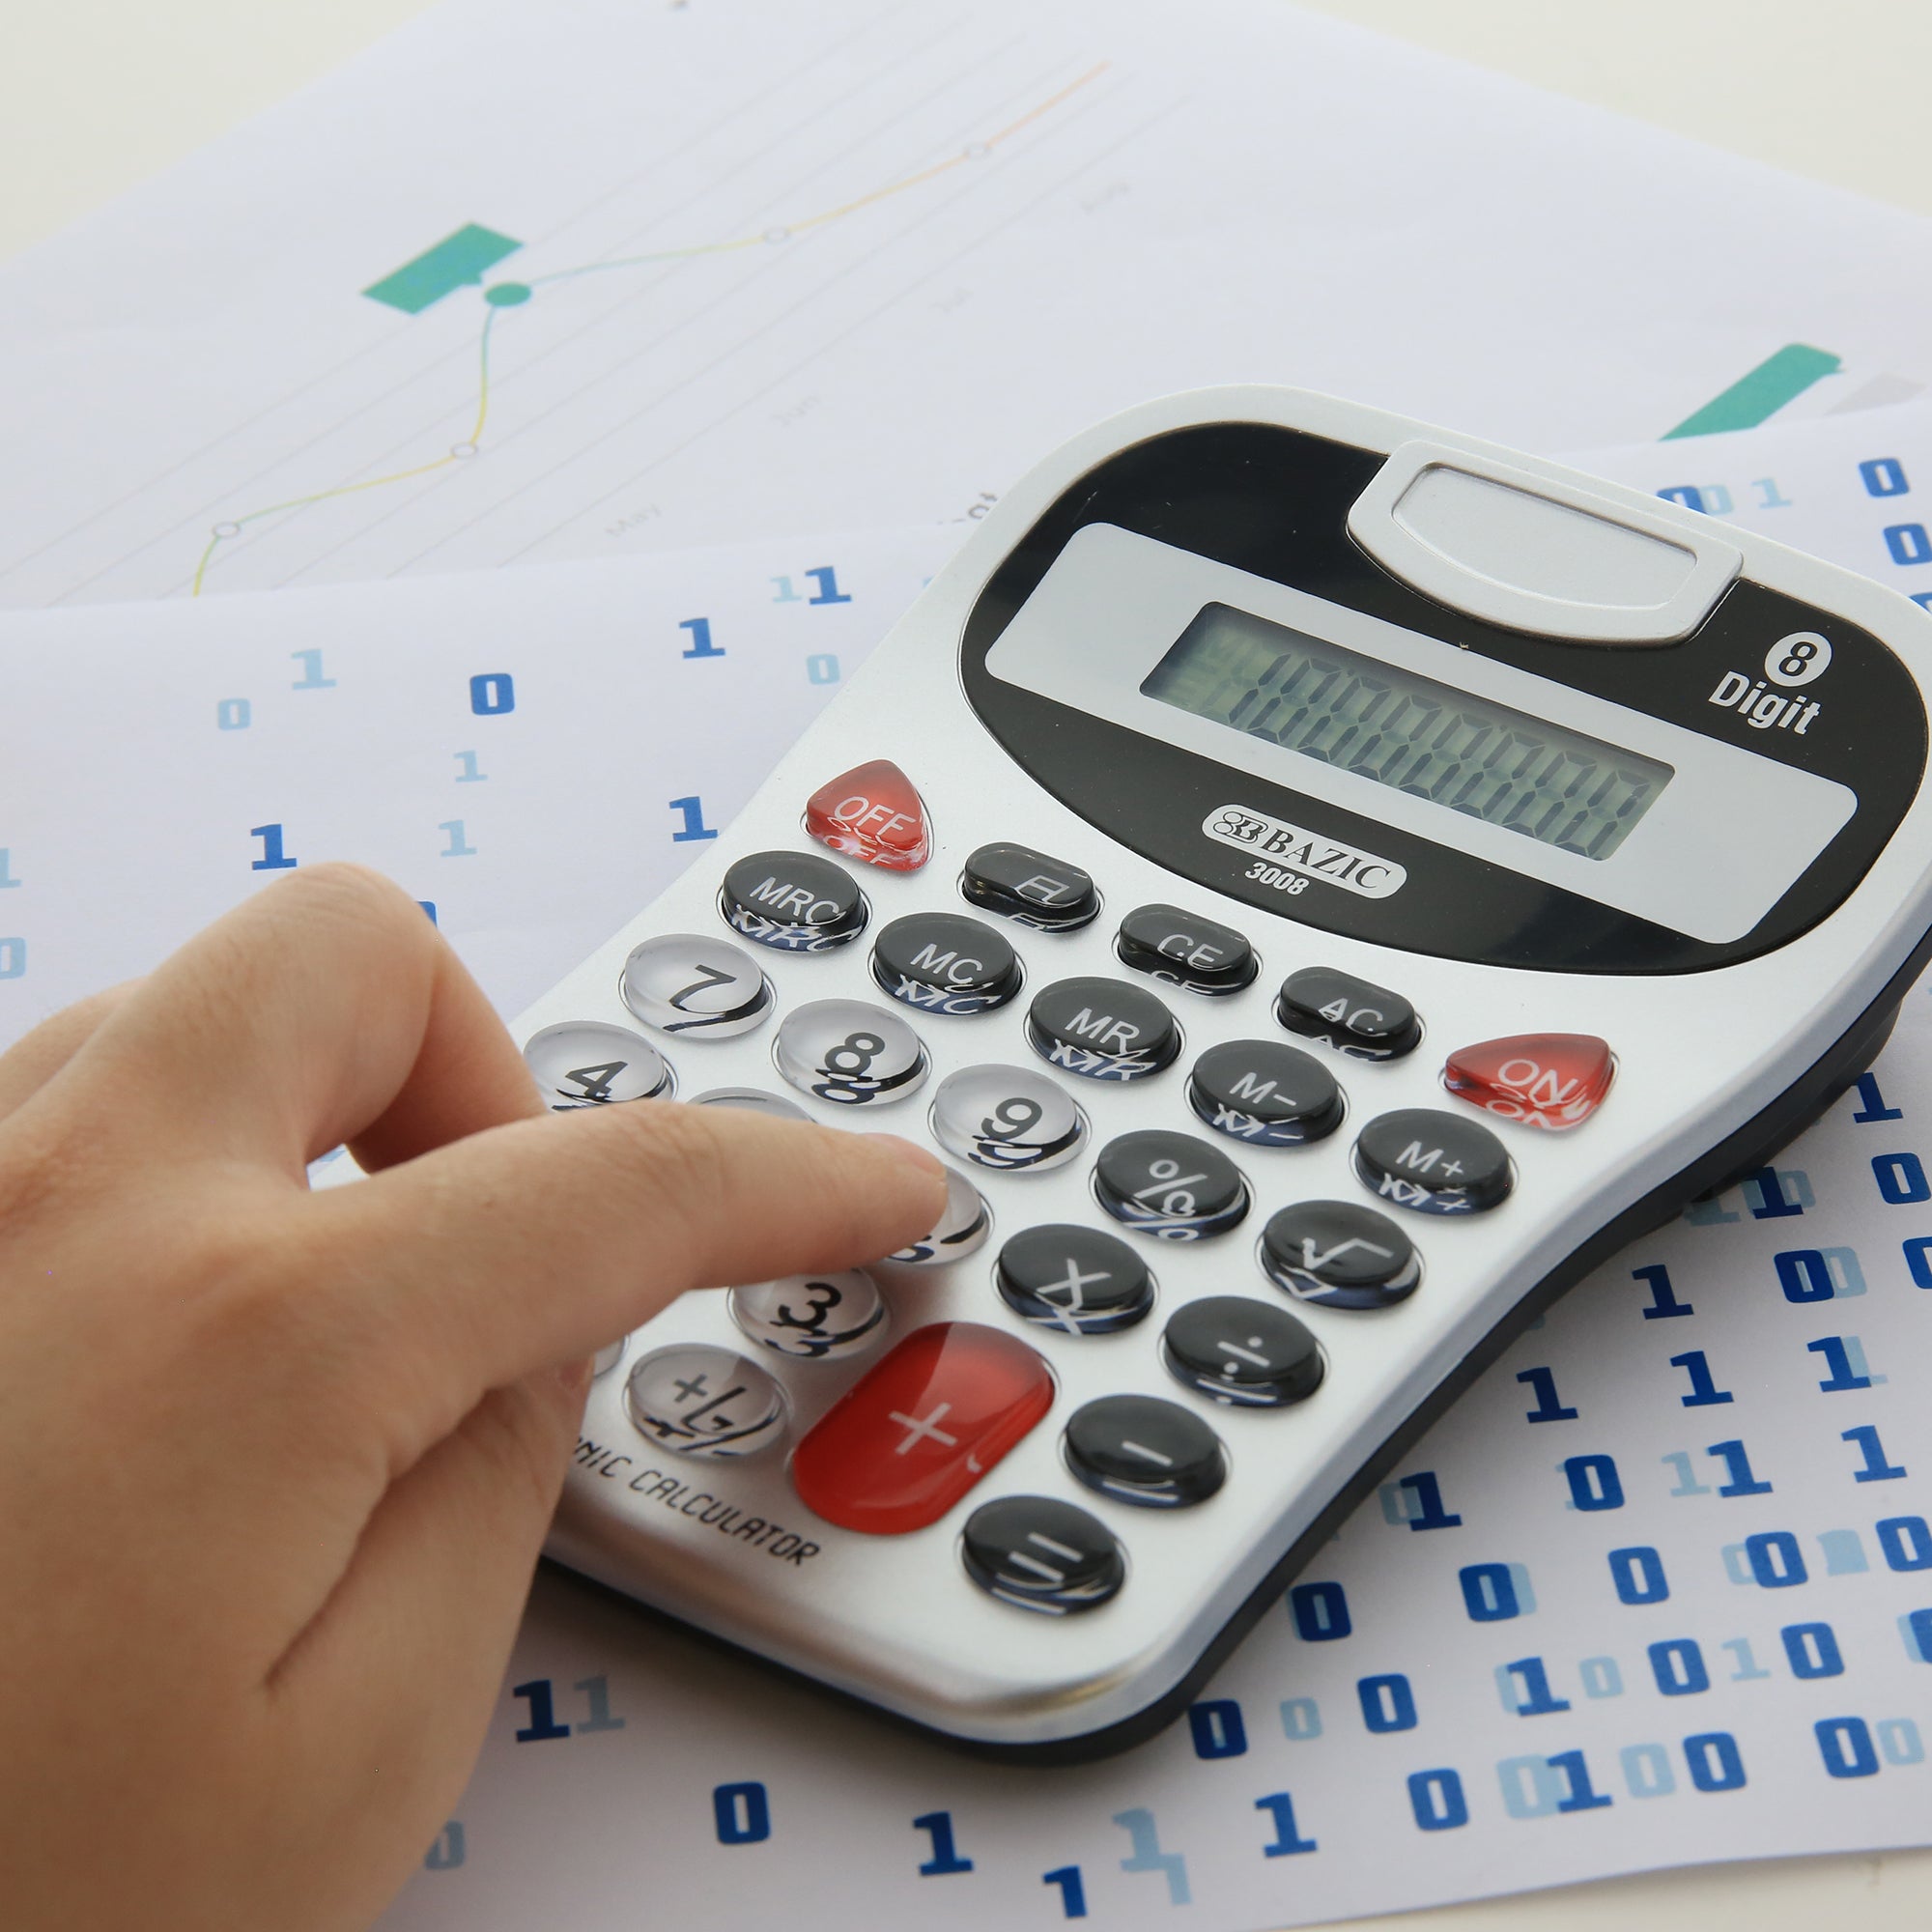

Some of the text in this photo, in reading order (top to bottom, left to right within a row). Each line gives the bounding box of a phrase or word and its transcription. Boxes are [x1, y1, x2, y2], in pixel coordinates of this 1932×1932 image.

[1751, 478, 1793, 510] 1
[1858, 457, 1911, 498] 0
[603, 502, 664, 539] May
[1882, 523, 1932, 567] 0
[771, 576, 803, 604] 1
[804, 566, 854, 607] 1
[678, 617, 727, 661] 1
[1778, 640, 1819, 678] 8
[293, 648, 338, 692] 1
[469, 672, 517, 717] 0
[807, 654, 841, 687] 0
[217, 697, 252, 731] 0
[1708, 669, 1822, 736] Digit
[454, 750, 489, 784] 1
[439, 819, 478, 859] 1
[669, 796, 720, 843] 1
[834, 795, 918, 838] OFF
[250, 823, 299, 872] 1
[1259, 828, 1392, 890] BAZIC
[749, 876, 845, 924] MRC
[1244, 861, 1311, 896] 3008
[909, 943, 983, 984] MC
[1157, 933, 1225, 969] CE
[668, 963, 737, 1011] 7
[1064, 1007, 1142, 1053] MR
[1317, 997, 1384, 1036] AC
[824, 1031, 887, 1076] 8
[564, 1060, 629, 1101] 4
[1497, 1059, 1579, 1108] ON
[1852, 1071, 1904, 1124] 1
[980, 1095, 1044, 1141] 9
[1395, 1140, 1465, 1178] M+
[1871, 1152, 1931, 1206] 0
[1743, 1166, 1804, 1219] 1
[1632, 1264, 1695, 1321] 1
[1774, 1249, 1835, 1304] 0
[777, 1281, 843, 1331] 3
[1669, 1350, 1735, 1407] 1
[1806, 1336, 1871, 1392] 1
[1516, 1366, 1579, 1424] 1
[1661, 1451, 1712, 1497] 1
[1707, 1439, 1774, 1498] 1
[1840, 1425, 1908, 1484] 1
[1400, 1471, 1463, 1531] 1
[1564, 1454, 1626, 1512] 0
[629, 1469, 821, 1567] CALCULATOR
[1874, 1515, 1932, 1573] 0
[1607, 1546, 1671, 1605] 0
[1746, 1530, 1809, 1588] 0
[1291, 1581, 1352, 1642] 0
[1459, 1562, 1520, 1623] 0
[1646, 1637, 1711, 1696] 0
[1719, 1637, 1772, 1682] 1
[1779, 1621, 1846, 1680] 0
[1355, 1672, 1420, 1734] 0
[1507, 1657, 1572, 1718] 1
[1578, 1655, 1625, 1700] 0
[512, 1679, 572, 1743] 1
[575, 1674, 626, 1735] 1
[1187, 1698, 1249, 1761] 0
[1279, 1696, 1323, 1742] 0
[1682, 1731, 1747, 1793] 0
[1812, 1716, 1880, 1779] 0
[1875, 1718, 1926, 1766] 0
[1495, 1754, 1563, 1820] 0
[1547, 1749, 1613, 1813] 1
[1618, 1742, 1677, 1799] 0
[713, 1781, 772, 1845] 0
[1253, 1790, 1320, 1859] 1
[1406, 1767, 1470, 1832] 0
[912, 1811, 976, 1877] 1
